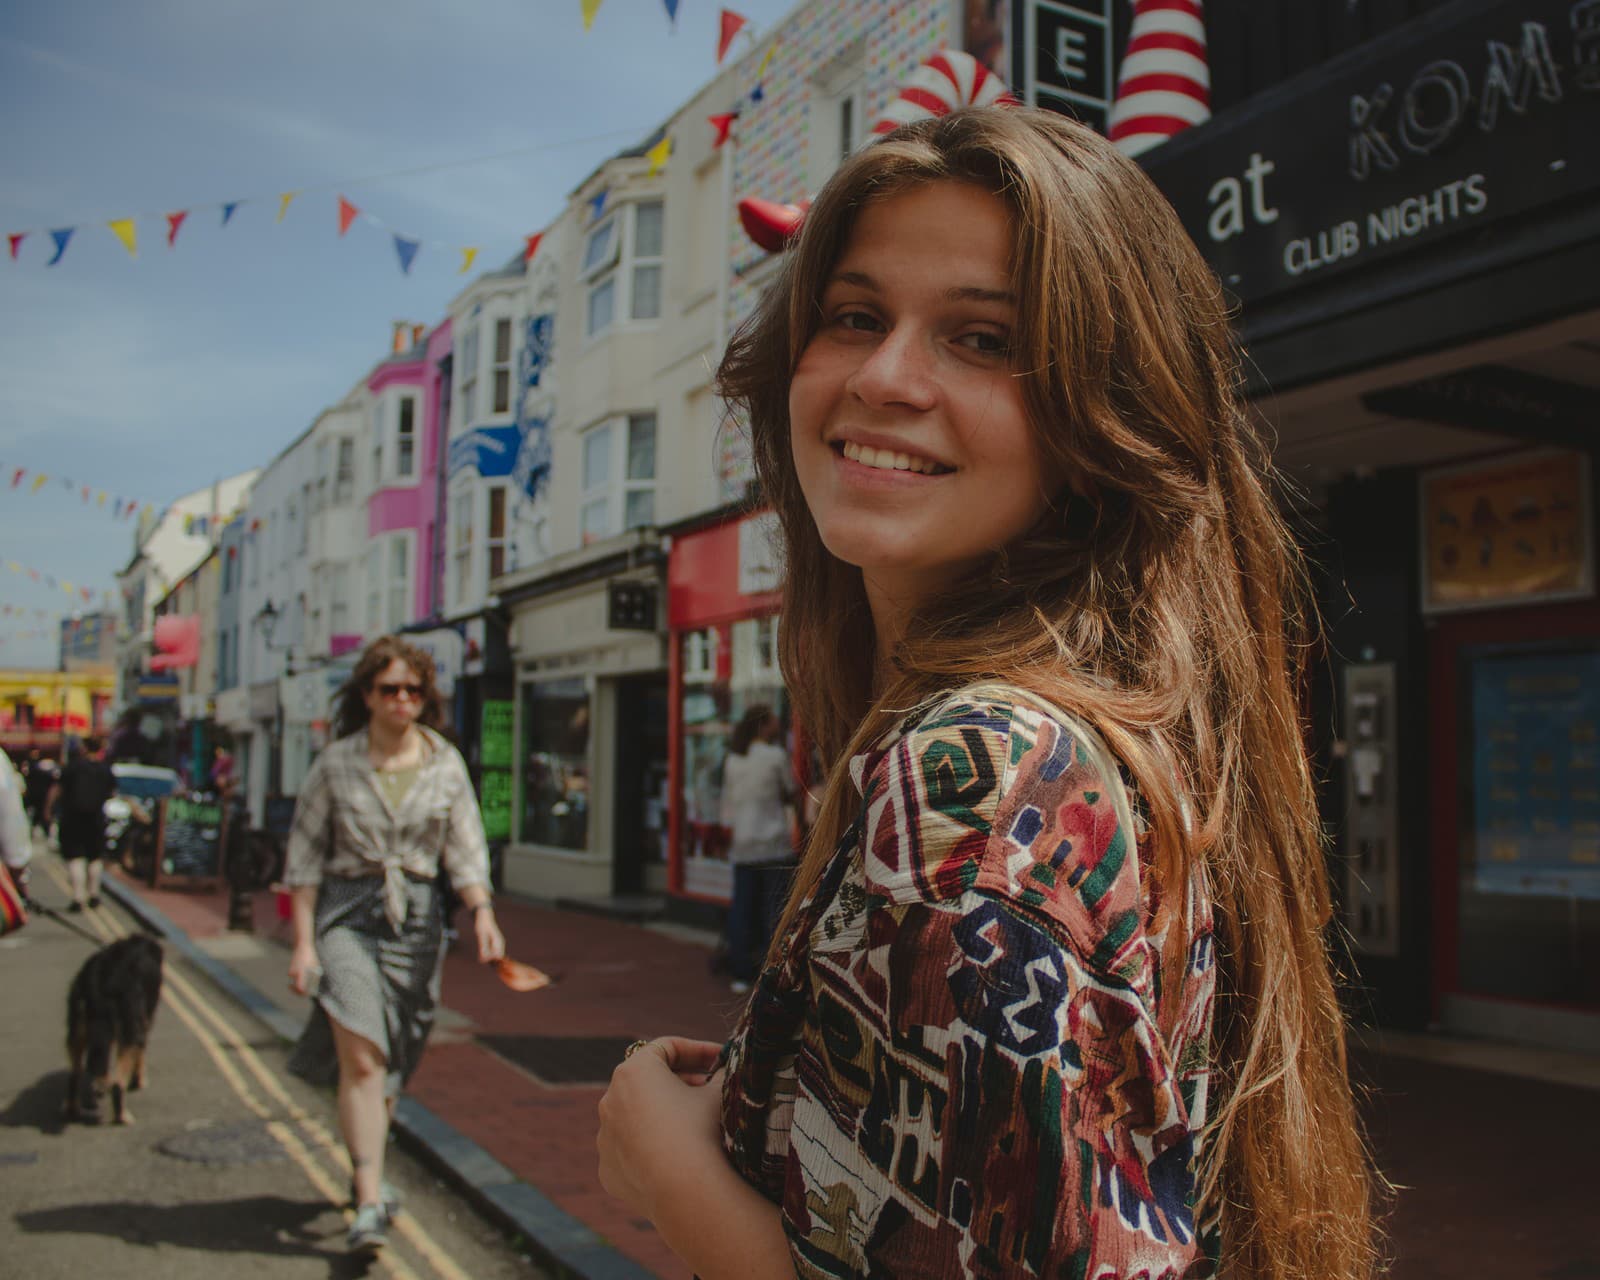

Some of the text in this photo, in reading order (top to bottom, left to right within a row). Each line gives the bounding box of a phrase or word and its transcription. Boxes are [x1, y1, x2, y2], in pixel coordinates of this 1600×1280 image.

[1207, 153, 1279, 241] at
[1283, 174, 1488, 276] CLUB NIGHTS
